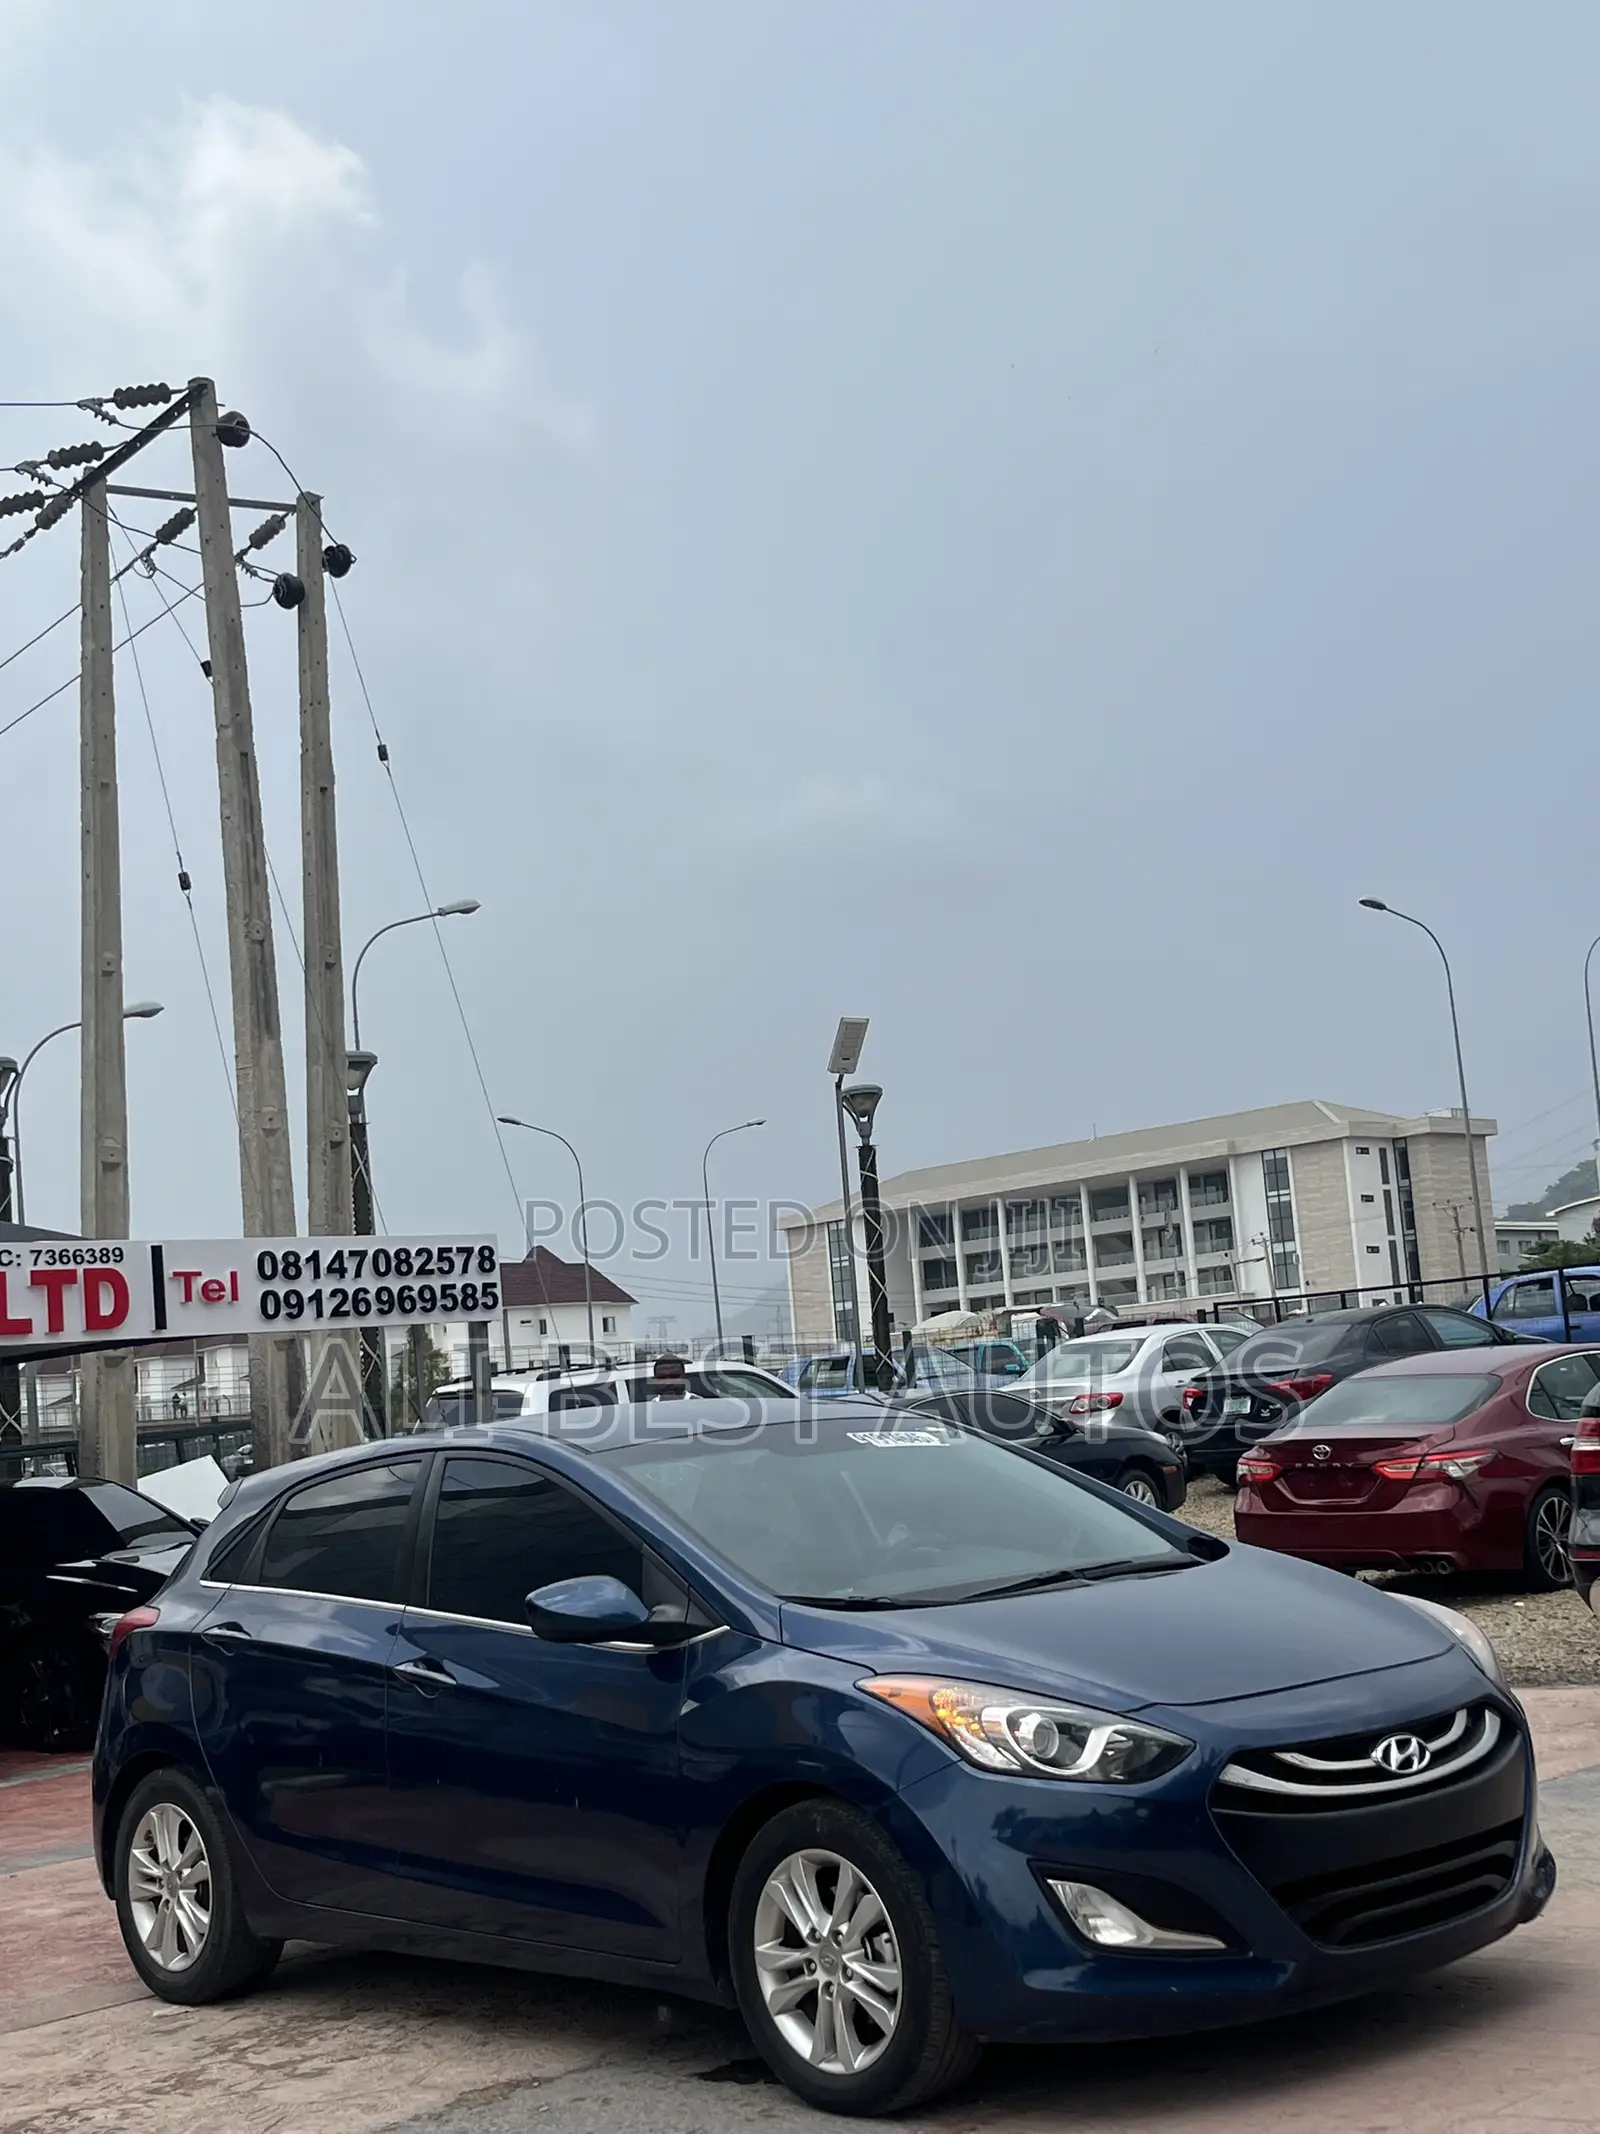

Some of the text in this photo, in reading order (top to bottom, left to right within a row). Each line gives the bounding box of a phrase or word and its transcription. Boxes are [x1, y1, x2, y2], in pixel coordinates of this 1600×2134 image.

[30, 1247, 124, 1266] 7366389
[257, 1245, 496, 1281] 08147082578
[0, 1267, 130, 1335] LTD
[171, 1271, 239, 1304] Tel
[260, 1282, 499, 1320] 09126969585
